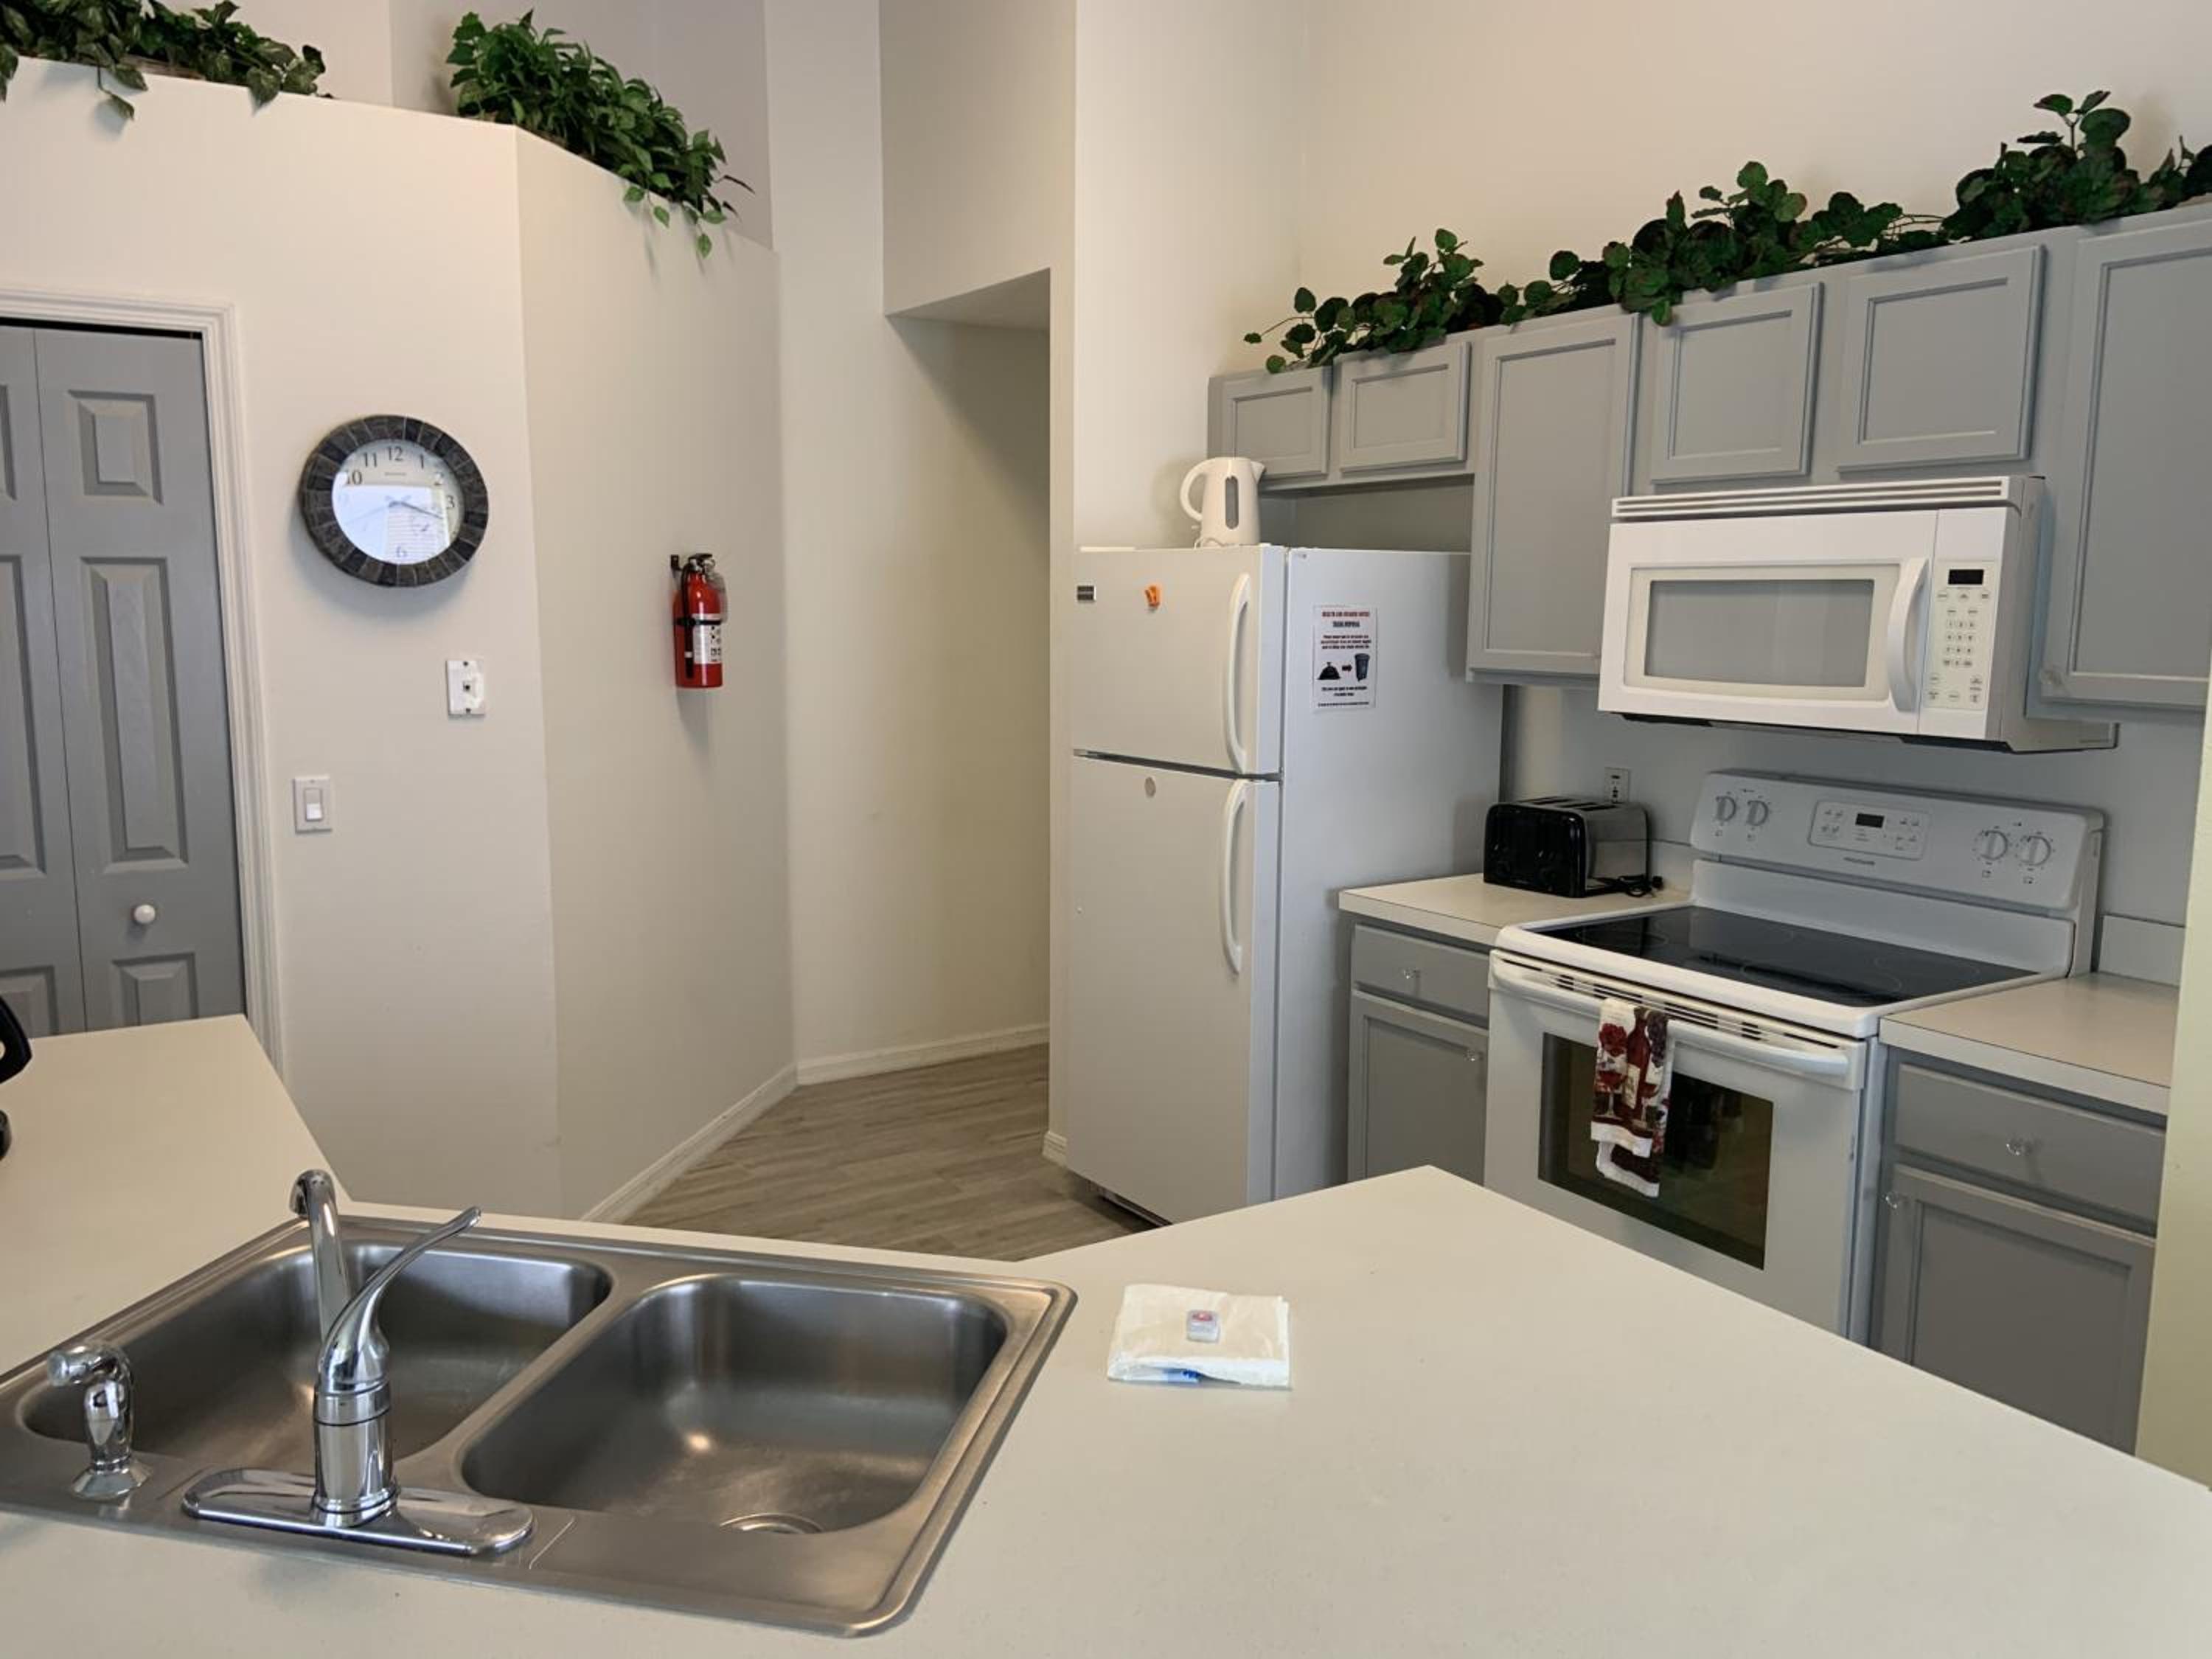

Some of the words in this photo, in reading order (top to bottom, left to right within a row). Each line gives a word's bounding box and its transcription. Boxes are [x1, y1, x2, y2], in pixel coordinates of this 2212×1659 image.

[364, 452, 378, 467] 11
[387, 446, 403, 461] 12
[420, 453, 425, 469] 1
[446, 495, 455, 508] 3
